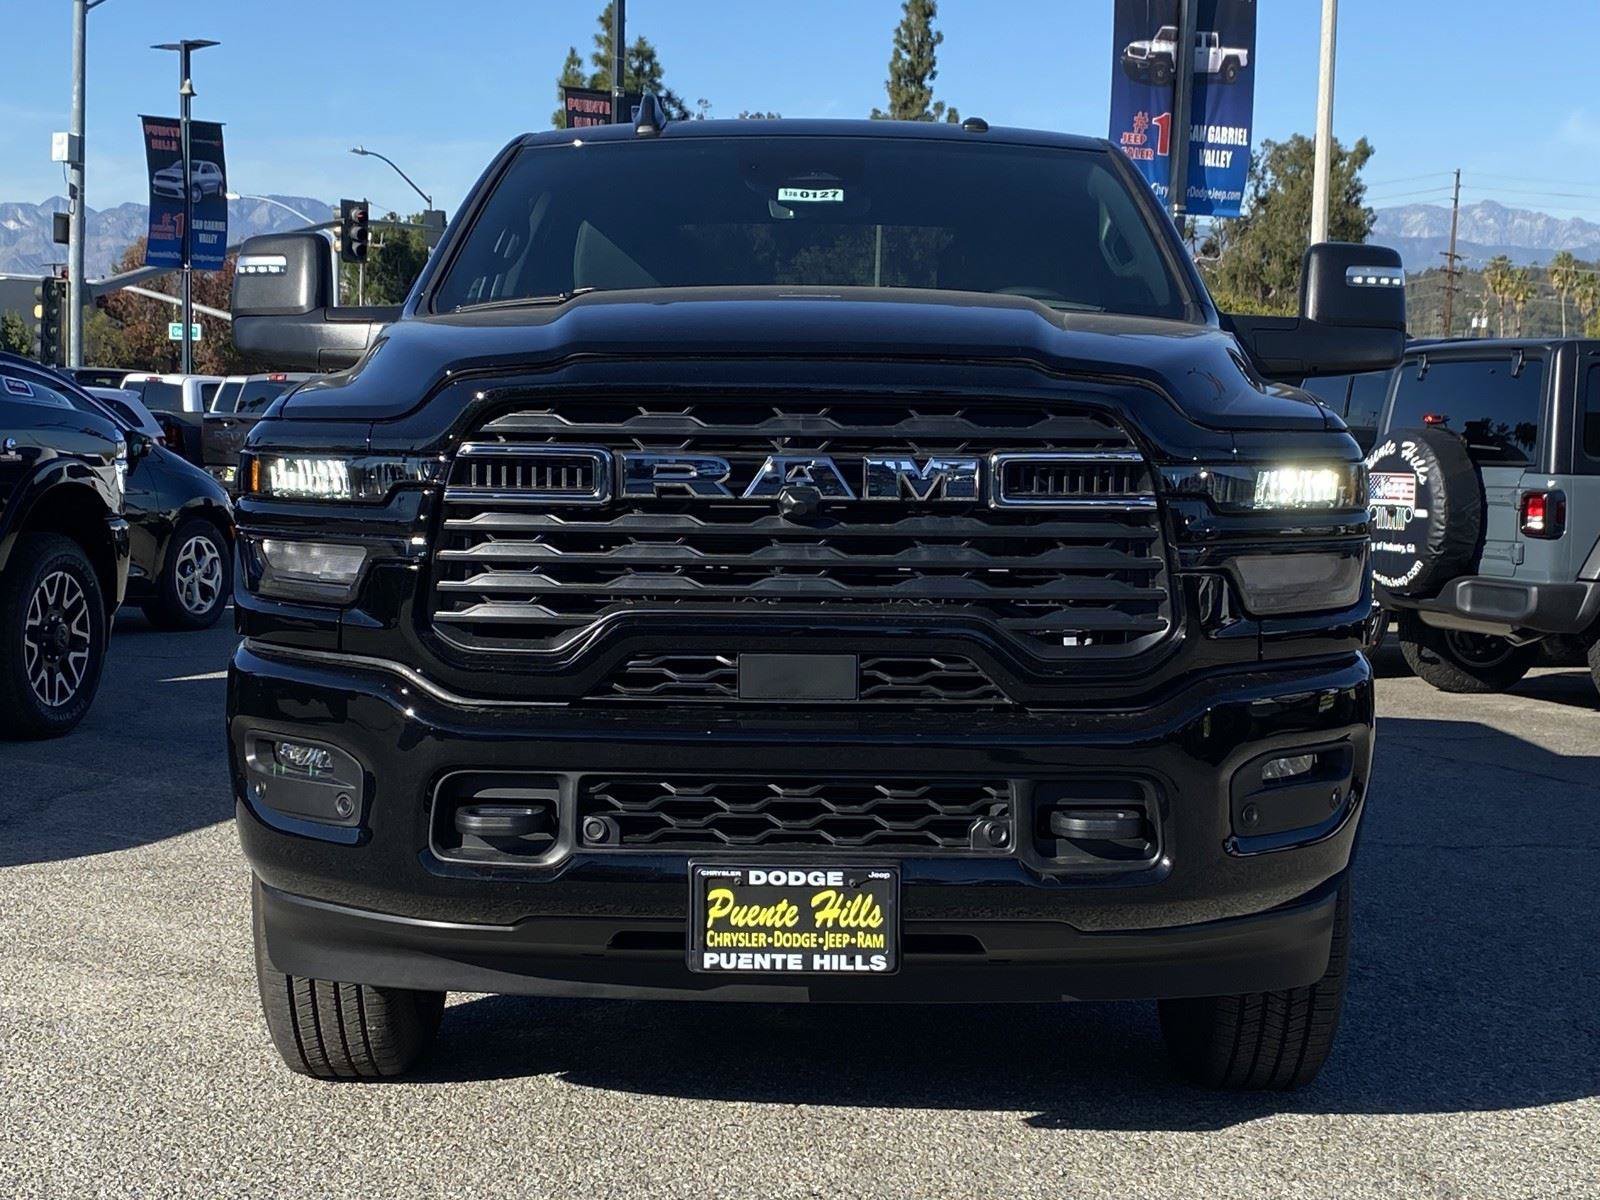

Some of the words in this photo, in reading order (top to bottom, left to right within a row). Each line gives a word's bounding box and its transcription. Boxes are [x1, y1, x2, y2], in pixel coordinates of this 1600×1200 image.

[1120, 132, 1148, 145] JEEP
[1207, 125, 1248, 146] GABRIEL
[1121, 146, 1154, 161] ALER
[1199, 149, 1233, 168] VALLEY
[799, 190, 839, 199] 0127
[1364, 439, 1396, 470] uente
[619, 452, 981, 500] RAM
[748, 870, 844, 886] DODGE
[868, 871, 891, 879] Jeep
[707, 888, 800, 929] Puente
[810, 889, 884, 929] Hills
[703, 953, 803, 970] PUENTE
[812, 954, 888, 971] HILLS
